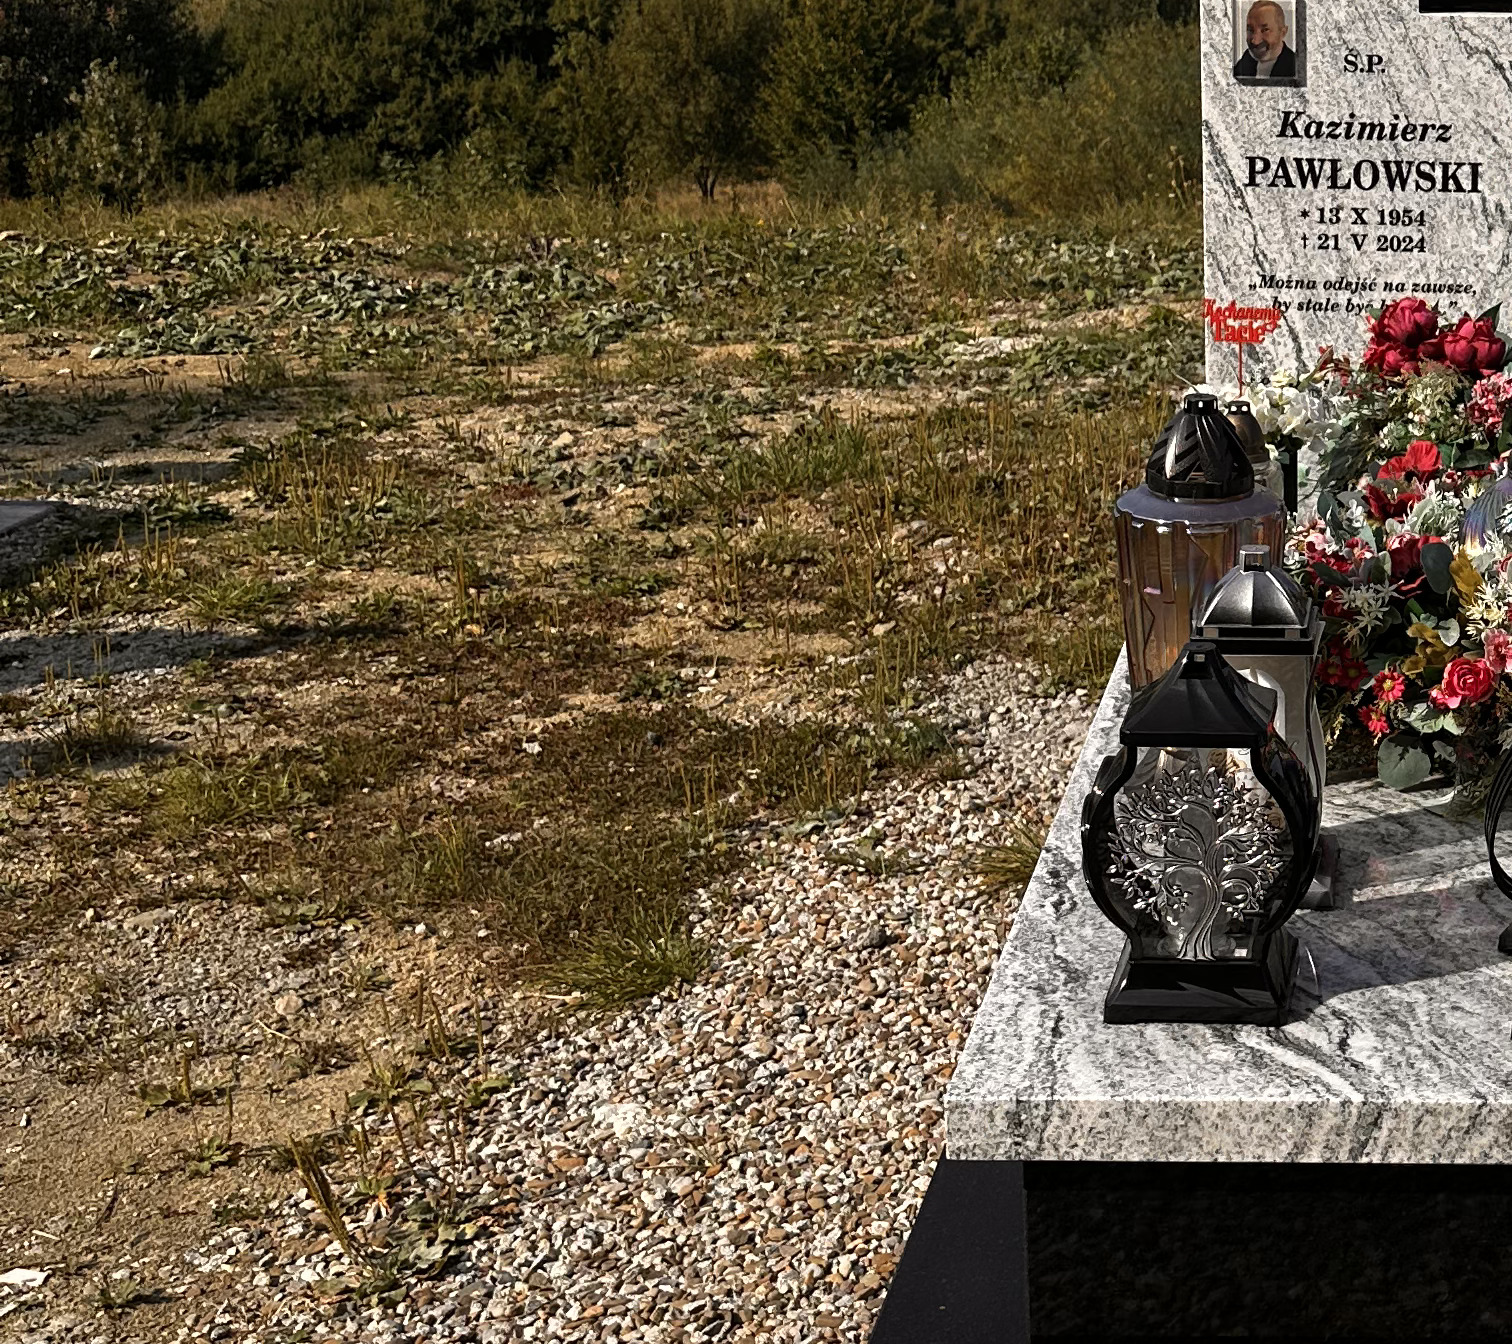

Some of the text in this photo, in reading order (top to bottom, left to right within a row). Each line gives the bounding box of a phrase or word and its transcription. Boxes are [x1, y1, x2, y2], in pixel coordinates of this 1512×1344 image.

[1343, 48, 1386, 74] Ś.P.
[1276, 110, 1453, 143] Kazimierz
[1244, 156, 1483, 194] PAWŁOWSKI
[1317, 207, 1427, 227] 13 X 1954
[1317, 233, 1341, 251] 21
[1350, 234, 1368, 252] V
[1376, 235, 1427, 253] 2024
[1323, 277, 1377, 295] odejść
[1383, 281, 1406, 293] na
[1411, 281, 1477, 296] zawsze,
[1297, 298, 1340, 313] stale
